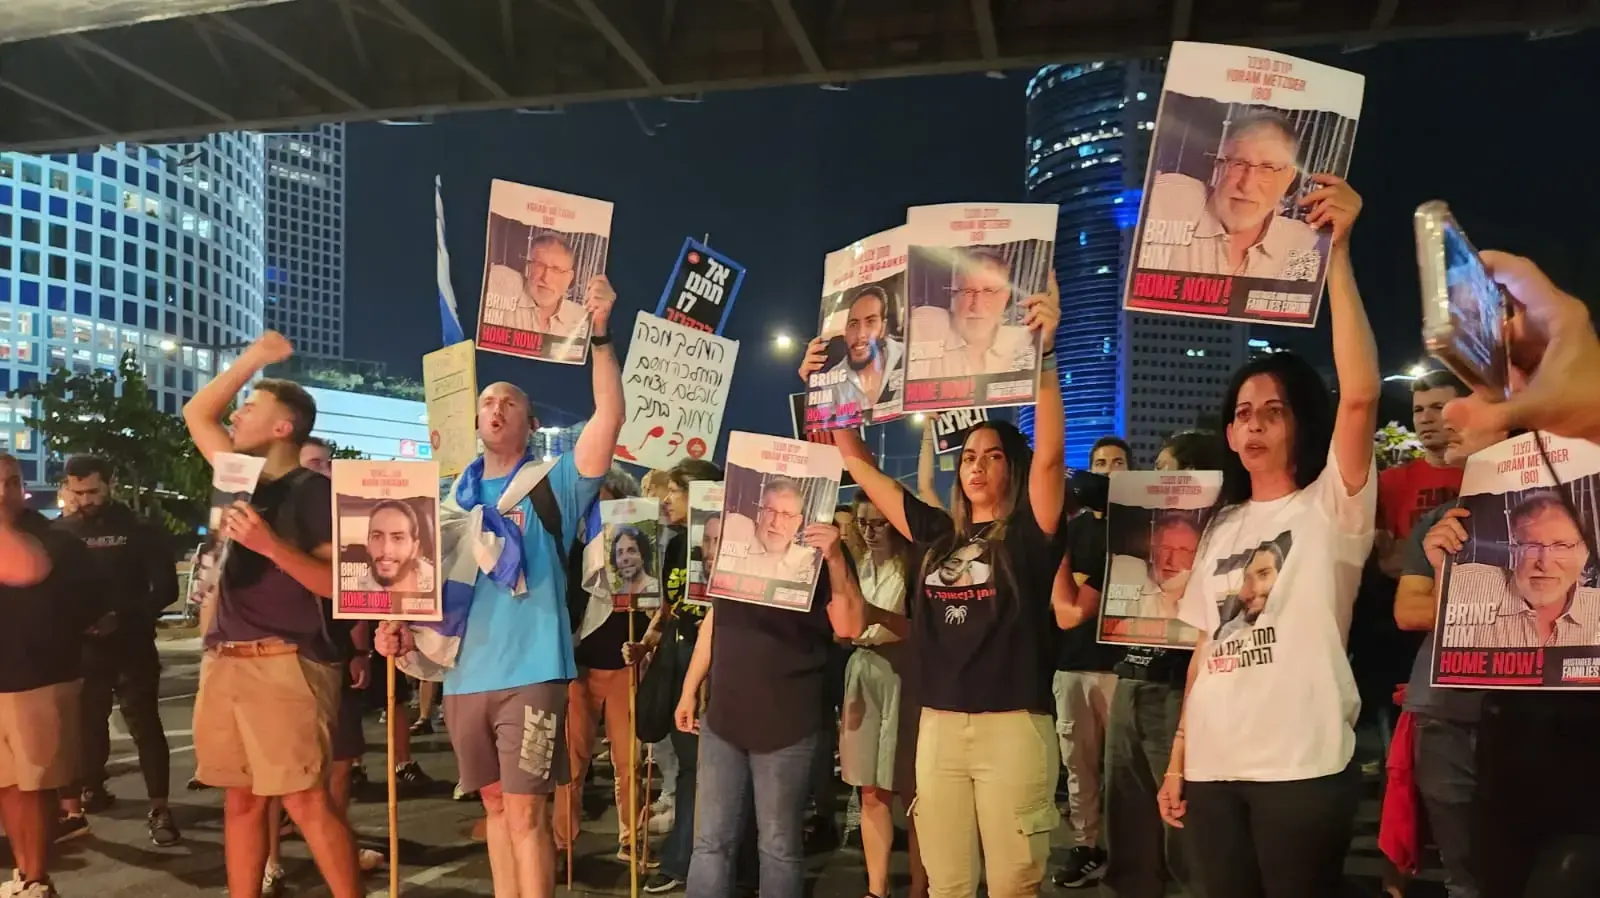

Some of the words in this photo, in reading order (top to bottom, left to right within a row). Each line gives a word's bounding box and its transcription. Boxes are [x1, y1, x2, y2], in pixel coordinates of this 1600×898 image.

[1144, 219, 1195, 246] BRING
[705, 257, 730, 286] אל
[684, 271, 724, 305] תתנו
[1133, 272, 1180, 299] HOME
[1181, 276, 1232, 305] NOW!
[675, 291, 698, 313] לו
[482, 325, 512, 347] HOME
[513, 329, 543, 351] NOW!
[673, 332, 725, 364] המלך
[809, 369, 848, 389] BRING
[808, 388, 833, 406] HIM
[1520, 469, 1540, 485] (80)
[340, 562, 368, 577] BRING
[341, 592, 367, 607] HOME
[368, 592, 392, 608] NOW!
[1446, 603, 1498, 625] BRING
[1442, 625, 1475, 648] HIM
[1242, 646, 1274, 668] הבית
[1440, 651, 1488, 674] HOME
[1492, 648, 1544, 675] NOW!
[1562, 666, 1600, 679] FAMILIES
